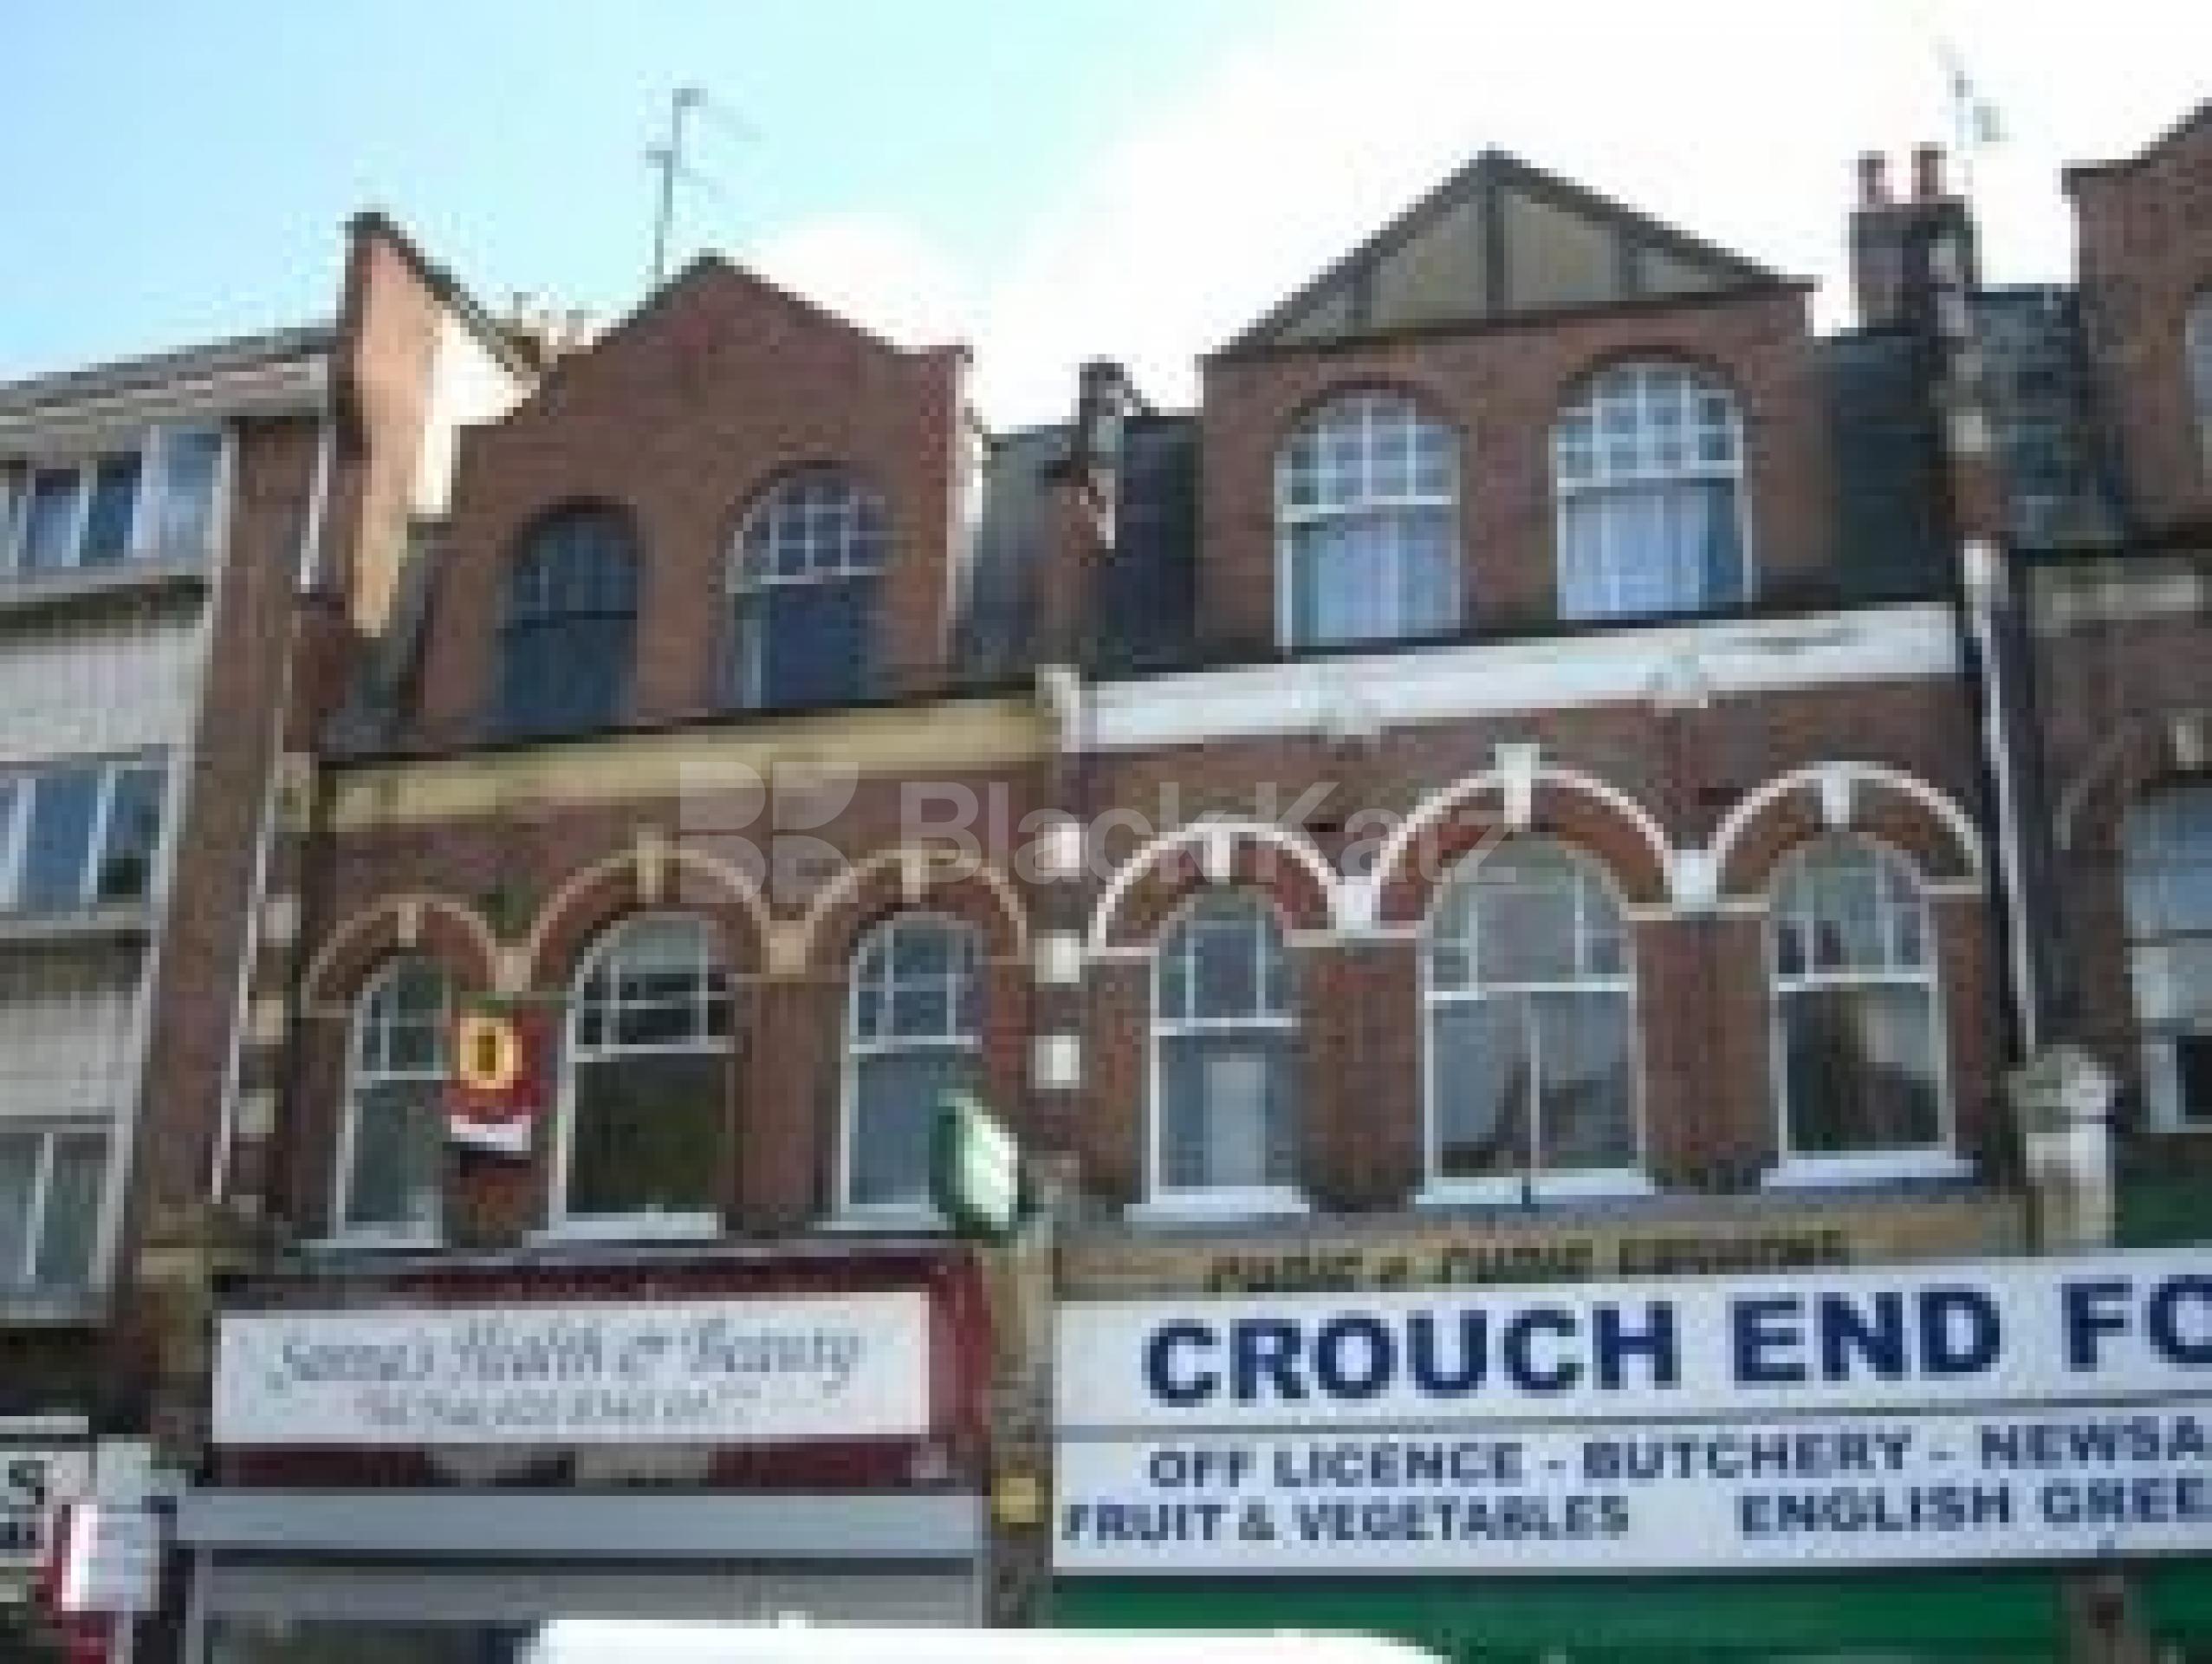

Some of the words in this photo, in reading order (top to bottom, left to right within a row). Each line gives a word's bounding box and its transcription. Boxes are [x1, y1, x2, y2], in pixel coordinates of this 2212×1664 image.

[1144, 1305, 1676, 1404] CROUCH
[1731, 1290, 2001, 1388] END
[2057, 1274, 2212, 1373] FO
[1149, 1449, 1248, 1489] OFF
[1274, 1442, 1523, 1487] LICENCE
[1584, 1433, 1910, 1479] BUTCHERY
[1062, 1503, 1222, 1541] FRUIT
[1239, 1505, 1277, 1541] &
[1300, 1494, 1631, 1541] VEGETABLES
[1742, 1485, 2010, 1537] ENGLISH
